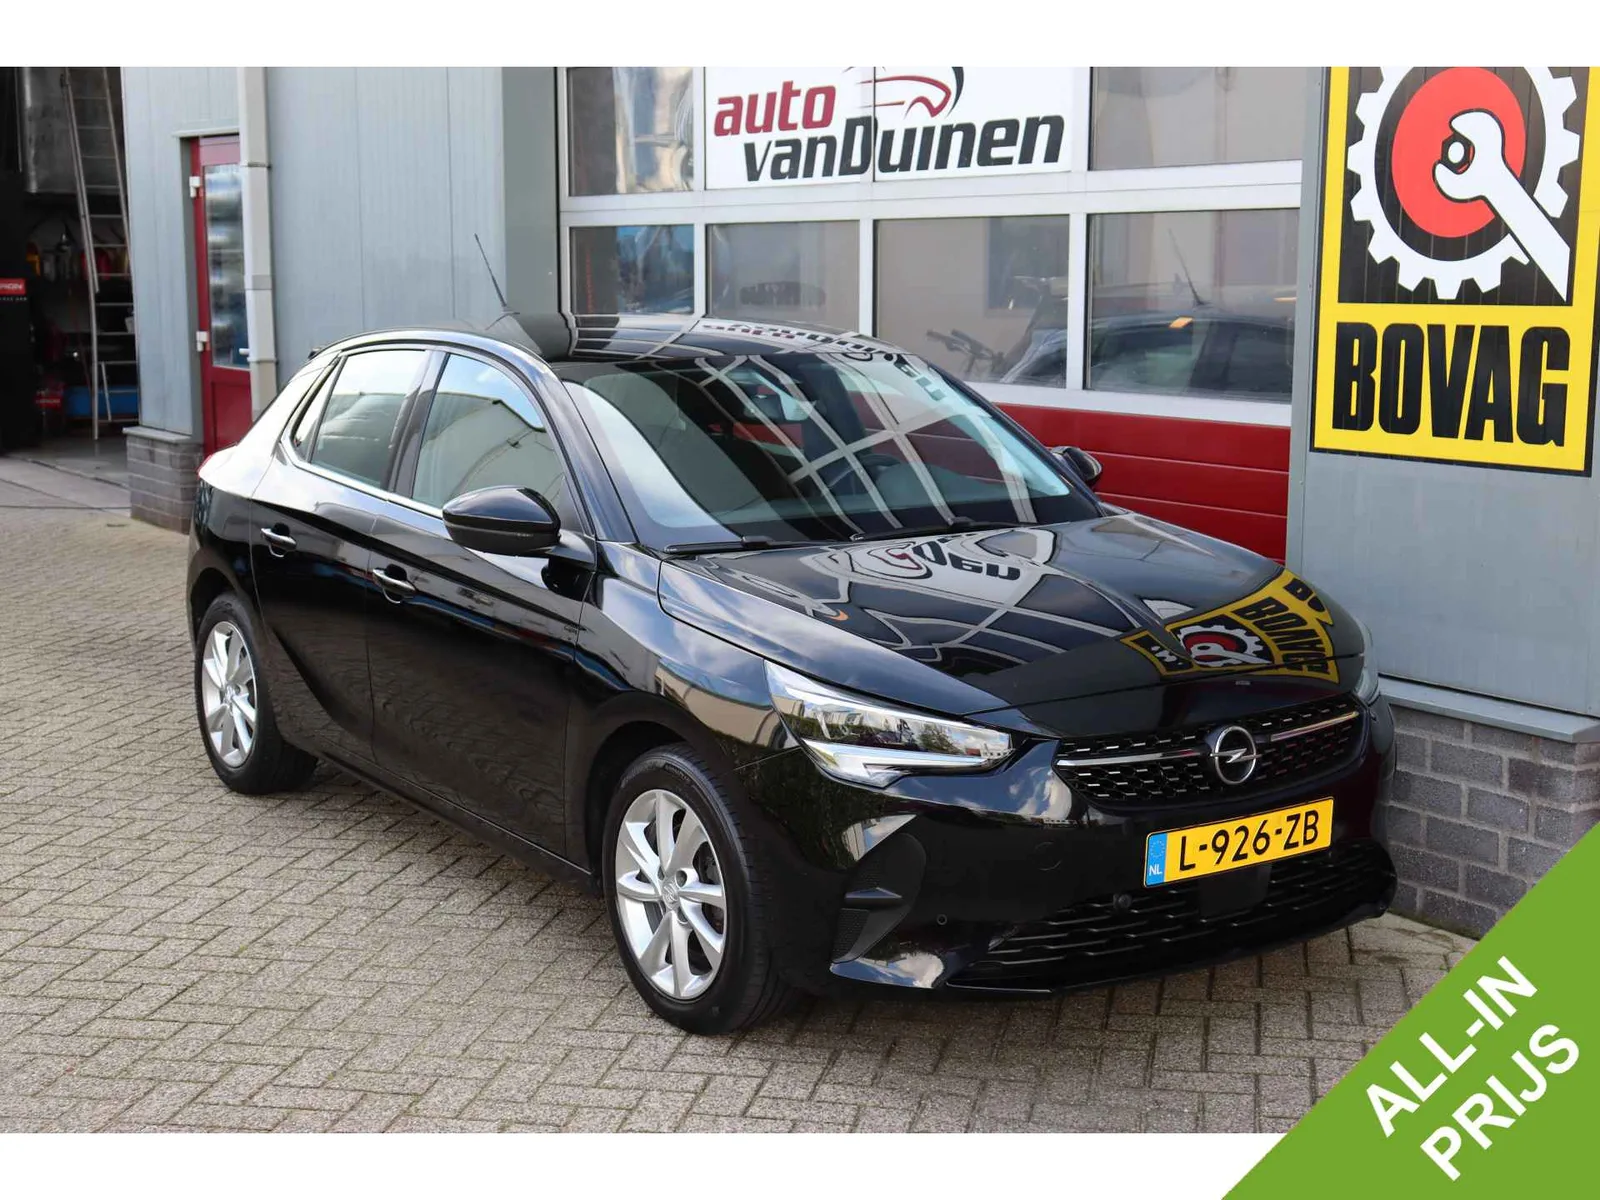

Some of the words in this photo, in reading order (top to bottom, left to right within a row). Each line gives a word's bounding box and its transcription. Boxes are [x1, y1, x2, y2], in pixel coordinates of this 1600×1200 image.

[714, 80, 836, 137] auto
[743, 114, 1065, 182] vanDuinen
[1332, 321, 1570, 447] BOVAG
[1149, 863, 1163, 876] NL
[1179, 809, 1319, 872] L-926-ZB
